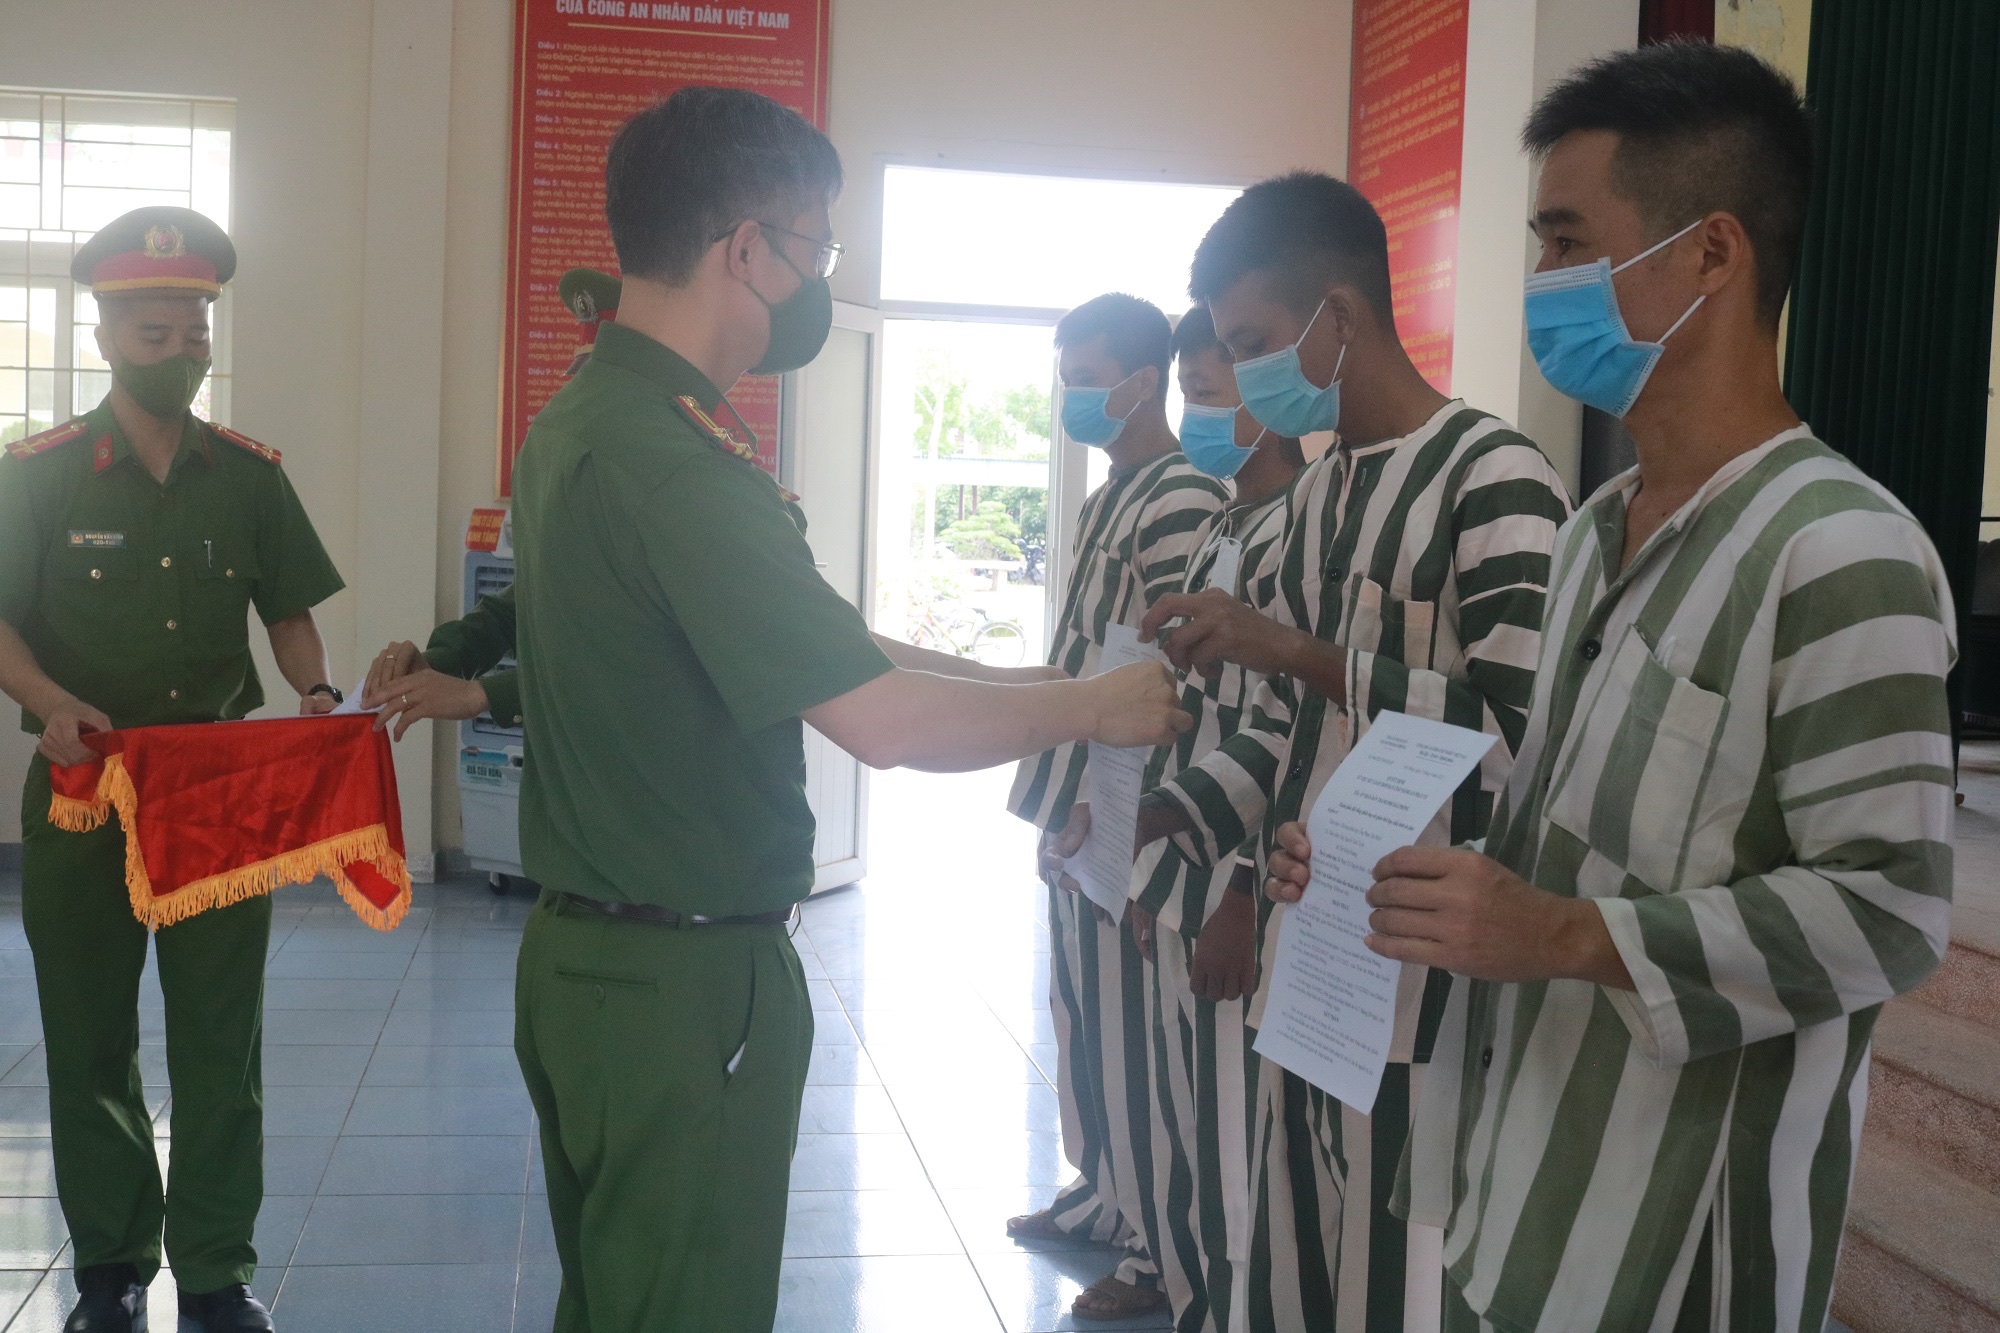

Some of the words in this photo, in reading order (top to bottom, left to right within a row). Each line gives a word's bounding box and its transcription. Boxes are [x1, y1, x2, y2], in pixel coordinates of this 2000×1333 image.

[629, 2, 648, 19] AN
[652, 2, 691, 22] NHÂN
[694, 4, 722, 25] DÂN
[725, 6, 755, 30] VIỆT
[757, 11, 789, 29] NAM
